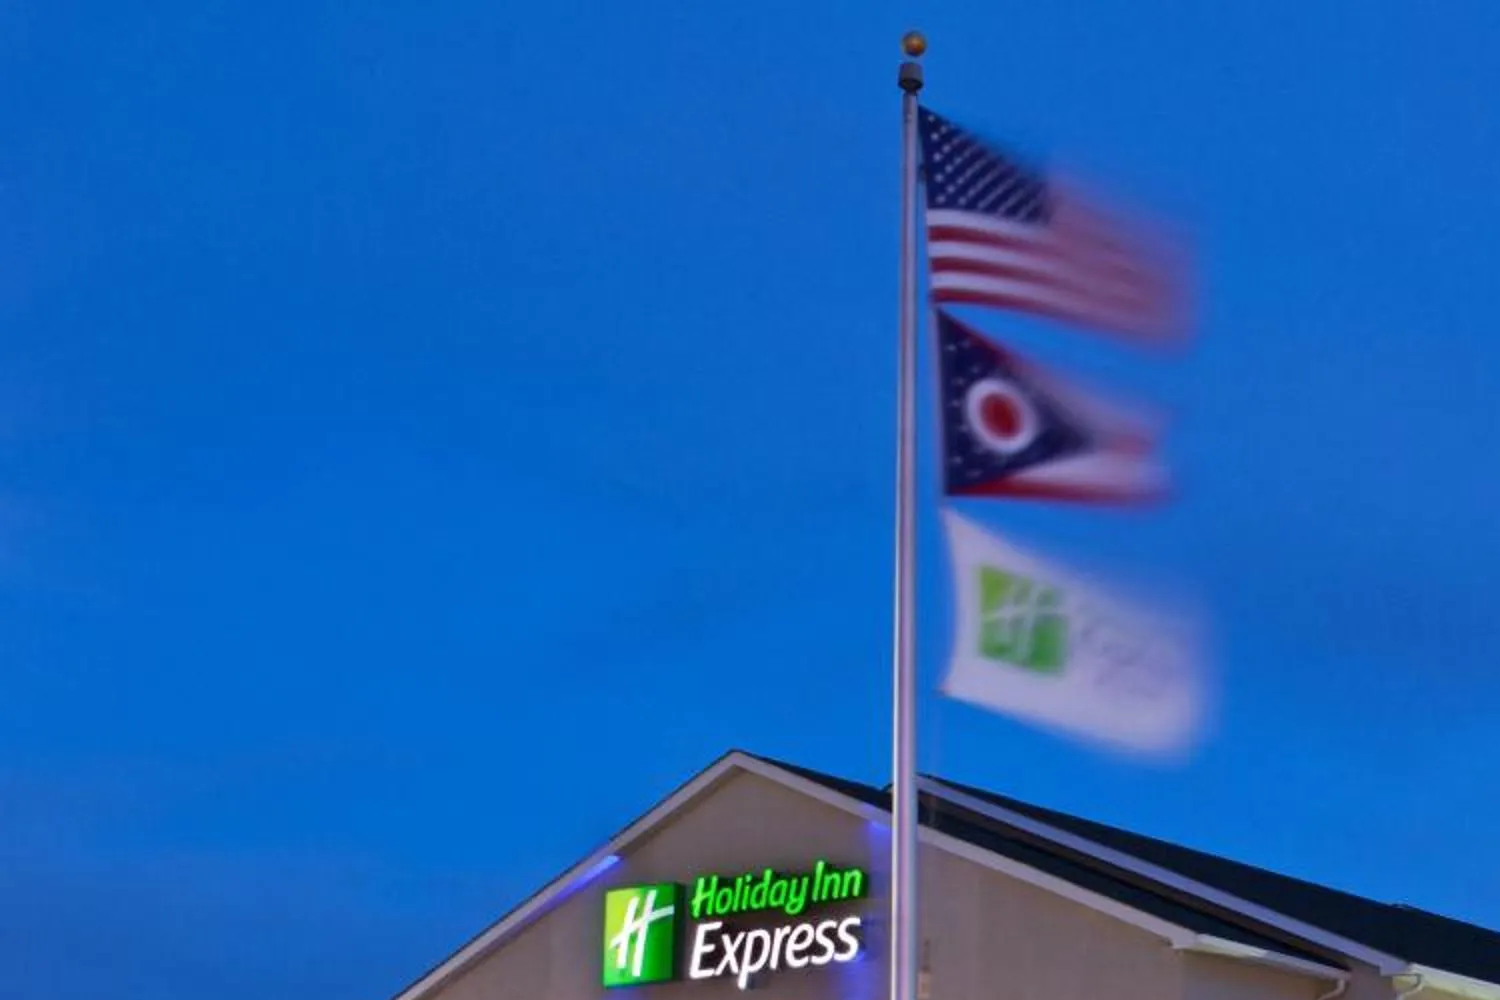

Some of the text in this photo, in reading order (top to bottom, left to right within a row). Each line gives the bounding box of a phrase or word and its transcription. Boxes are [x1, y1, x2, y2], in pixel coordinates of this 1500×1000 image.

[692, 860, 863, 916] Holiday Inn
[609, 888, 674, 977] H
[689, 916, 861, 990] Express
